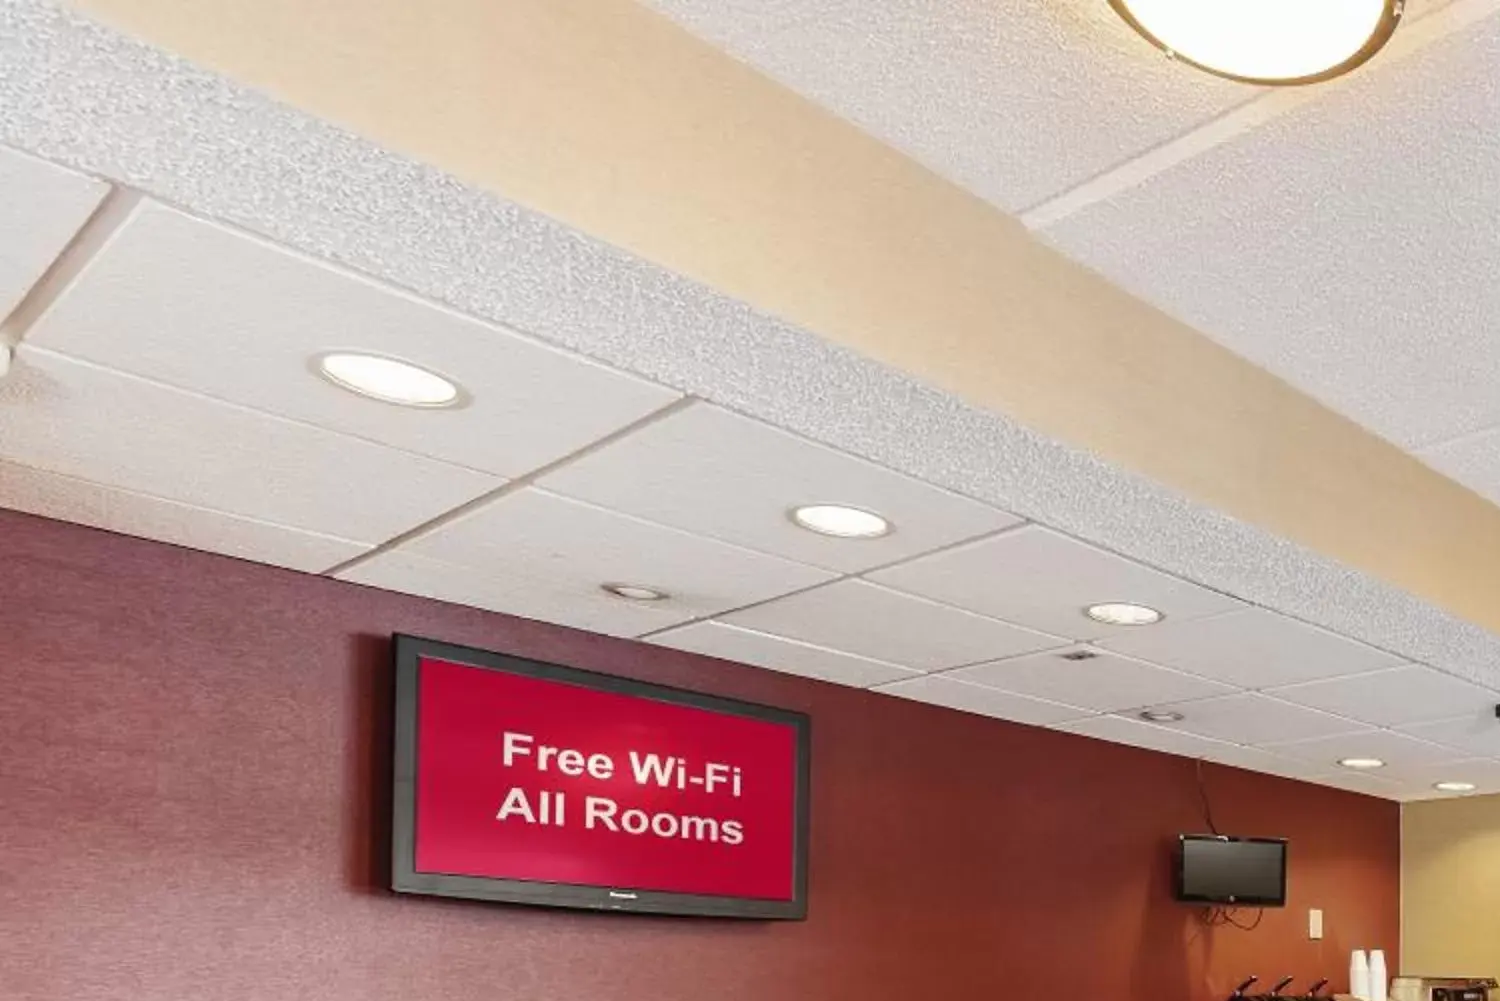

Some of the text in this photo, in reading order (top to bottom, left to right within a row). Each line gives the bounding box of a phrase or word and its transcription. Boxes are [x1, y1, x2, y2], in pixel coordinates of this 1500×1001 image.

[503, 732, 742, 797] Free Wi-Fi
[496, 787, 744, 845] All Rooms
